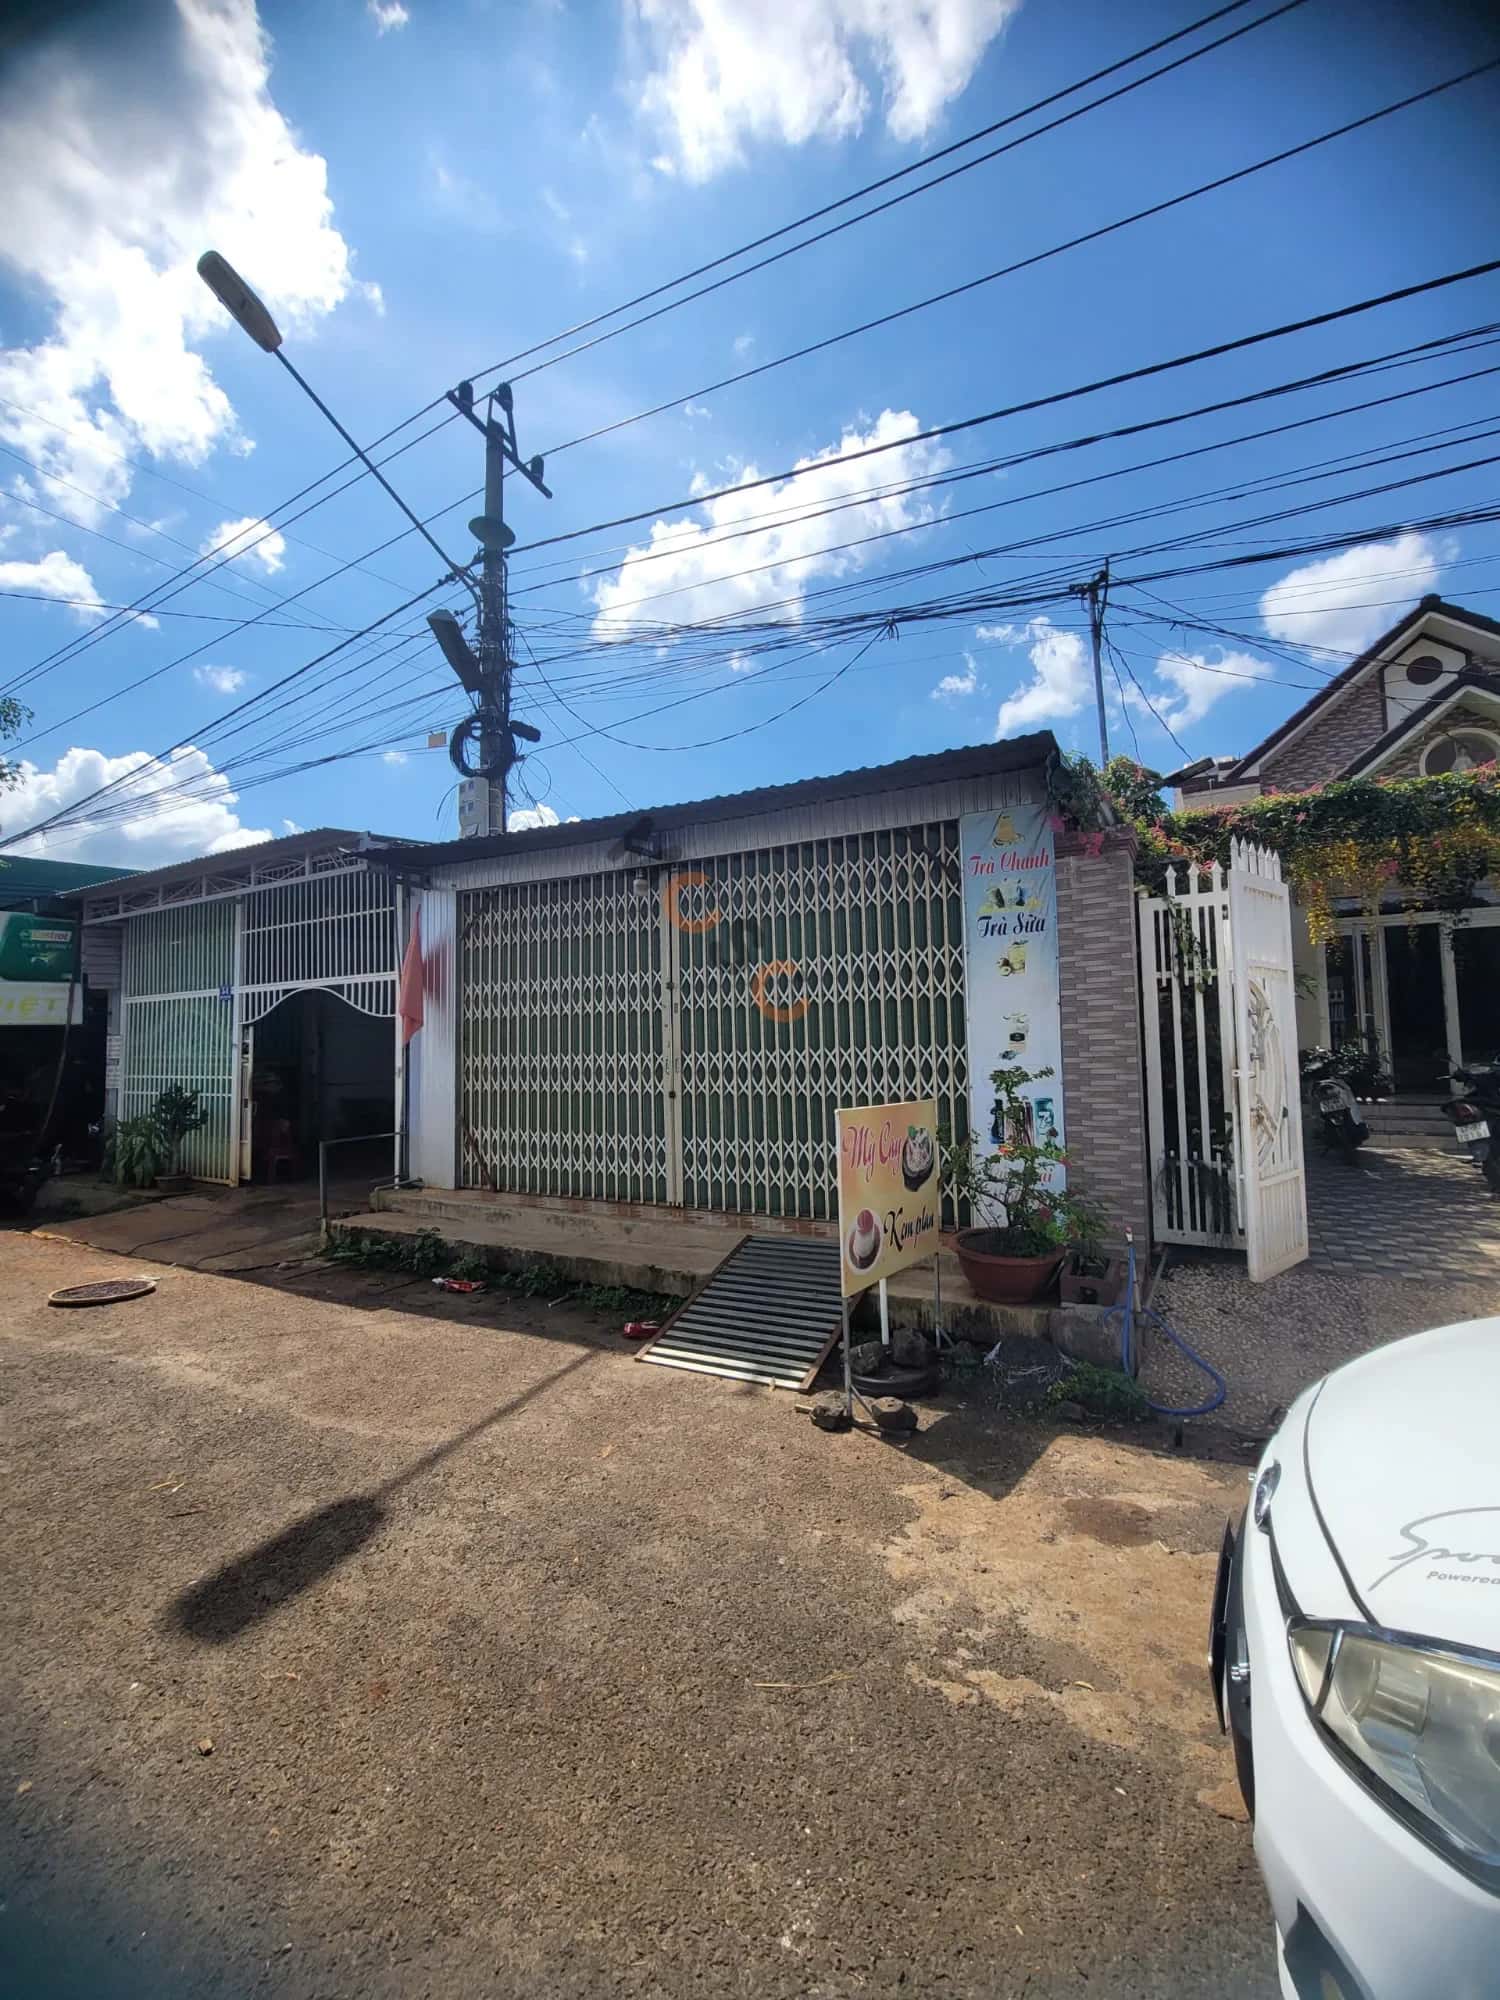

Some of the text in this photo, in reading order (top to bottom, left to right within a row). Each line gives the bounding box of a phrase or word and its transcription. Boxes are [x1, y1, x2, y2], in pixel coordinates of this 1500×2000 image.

[968, 848, 1050, 876] Trà Chanh
[977, 911, 1047, 938] Trà Sữa
[883, 1206, 914, 1252] Kem
